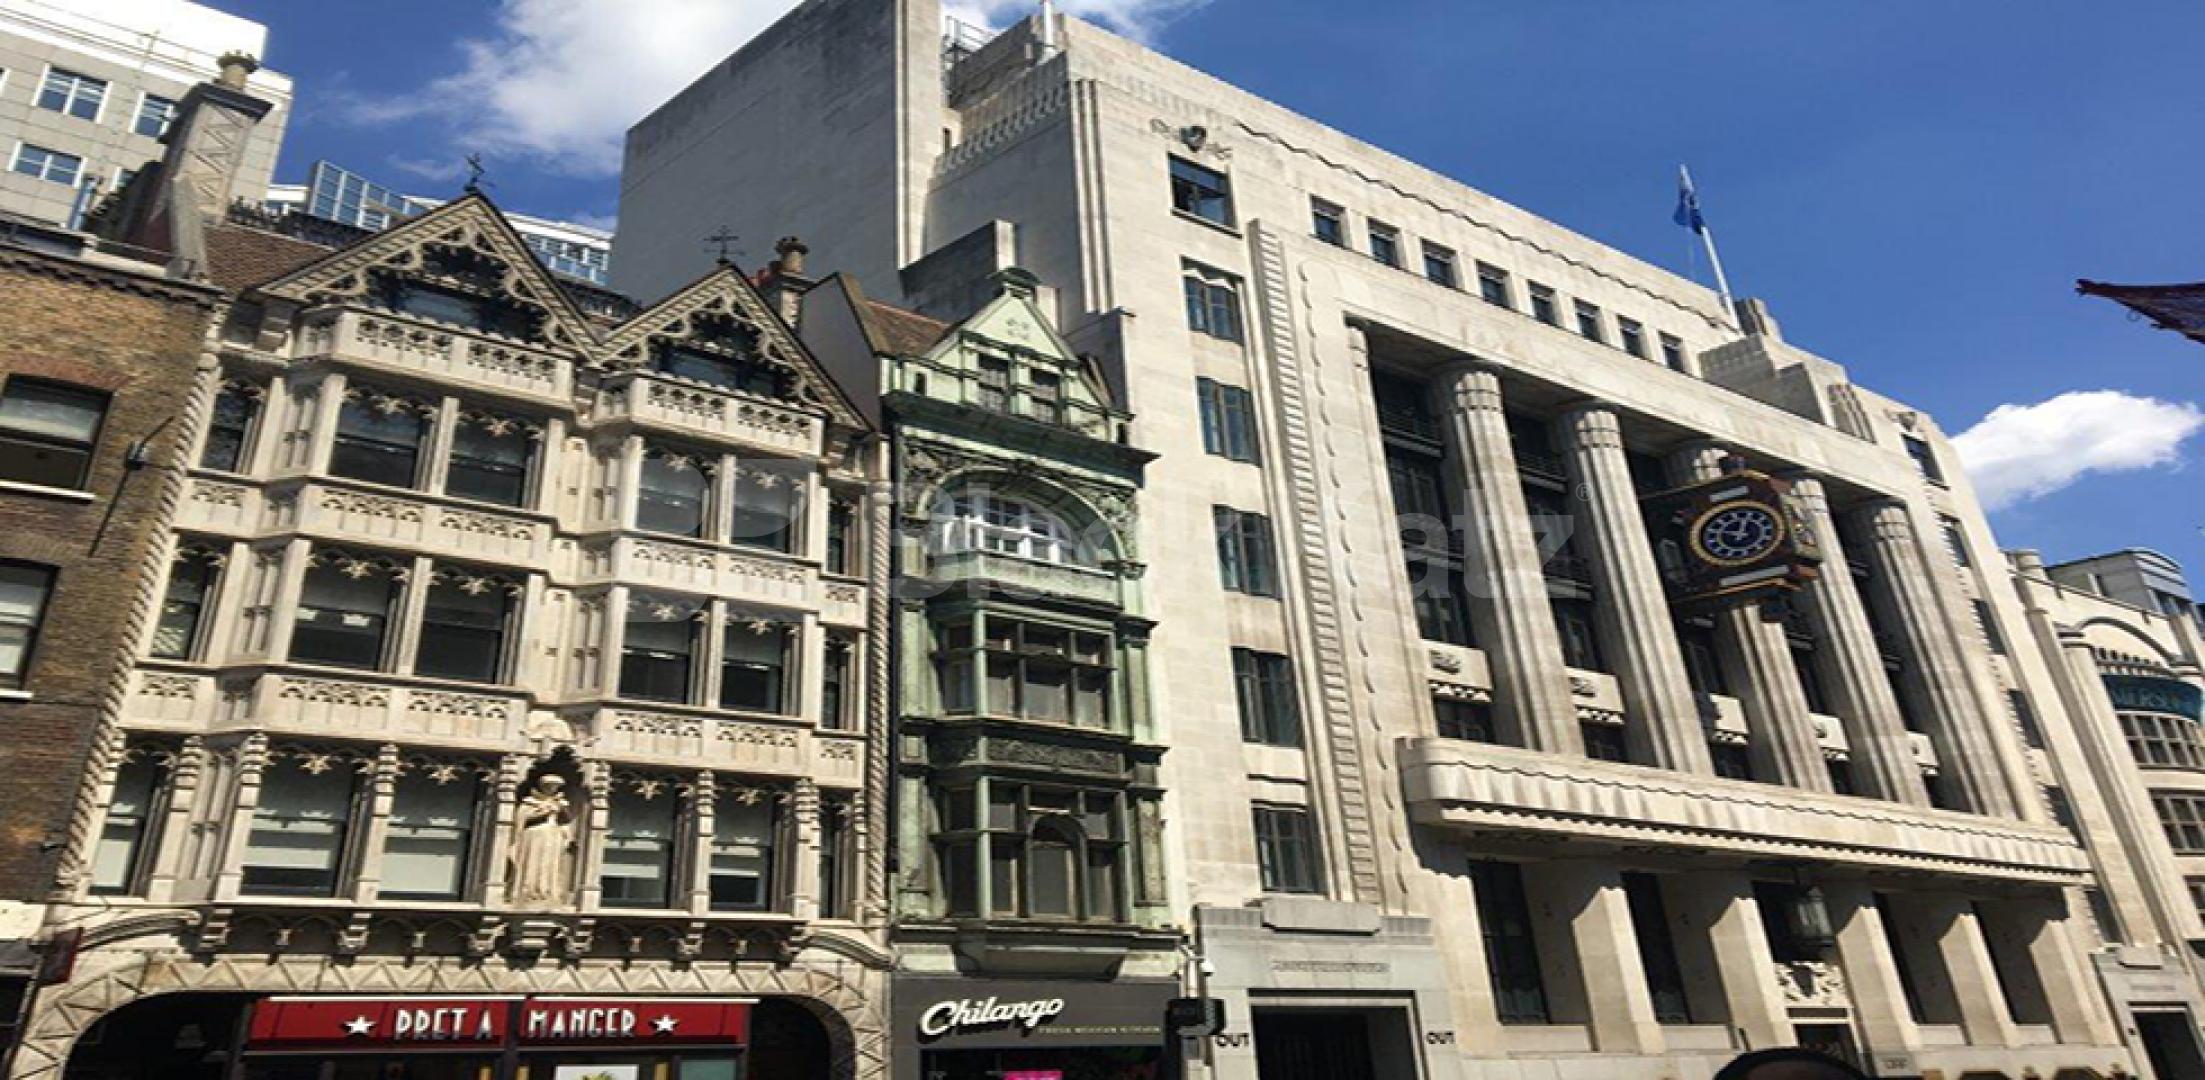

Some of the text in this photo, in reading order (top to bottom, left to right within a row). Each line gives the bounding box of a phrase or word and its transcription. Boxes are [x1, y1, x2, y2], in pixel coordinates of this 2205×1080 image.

[395, 1007, 637, 1040] PRET A MANGER
[919, 996, 1065, 1037] Chilango
[1215, 1033, 1250, 1048] OUT
[1426, 1030, 1456, 1045] OUT
